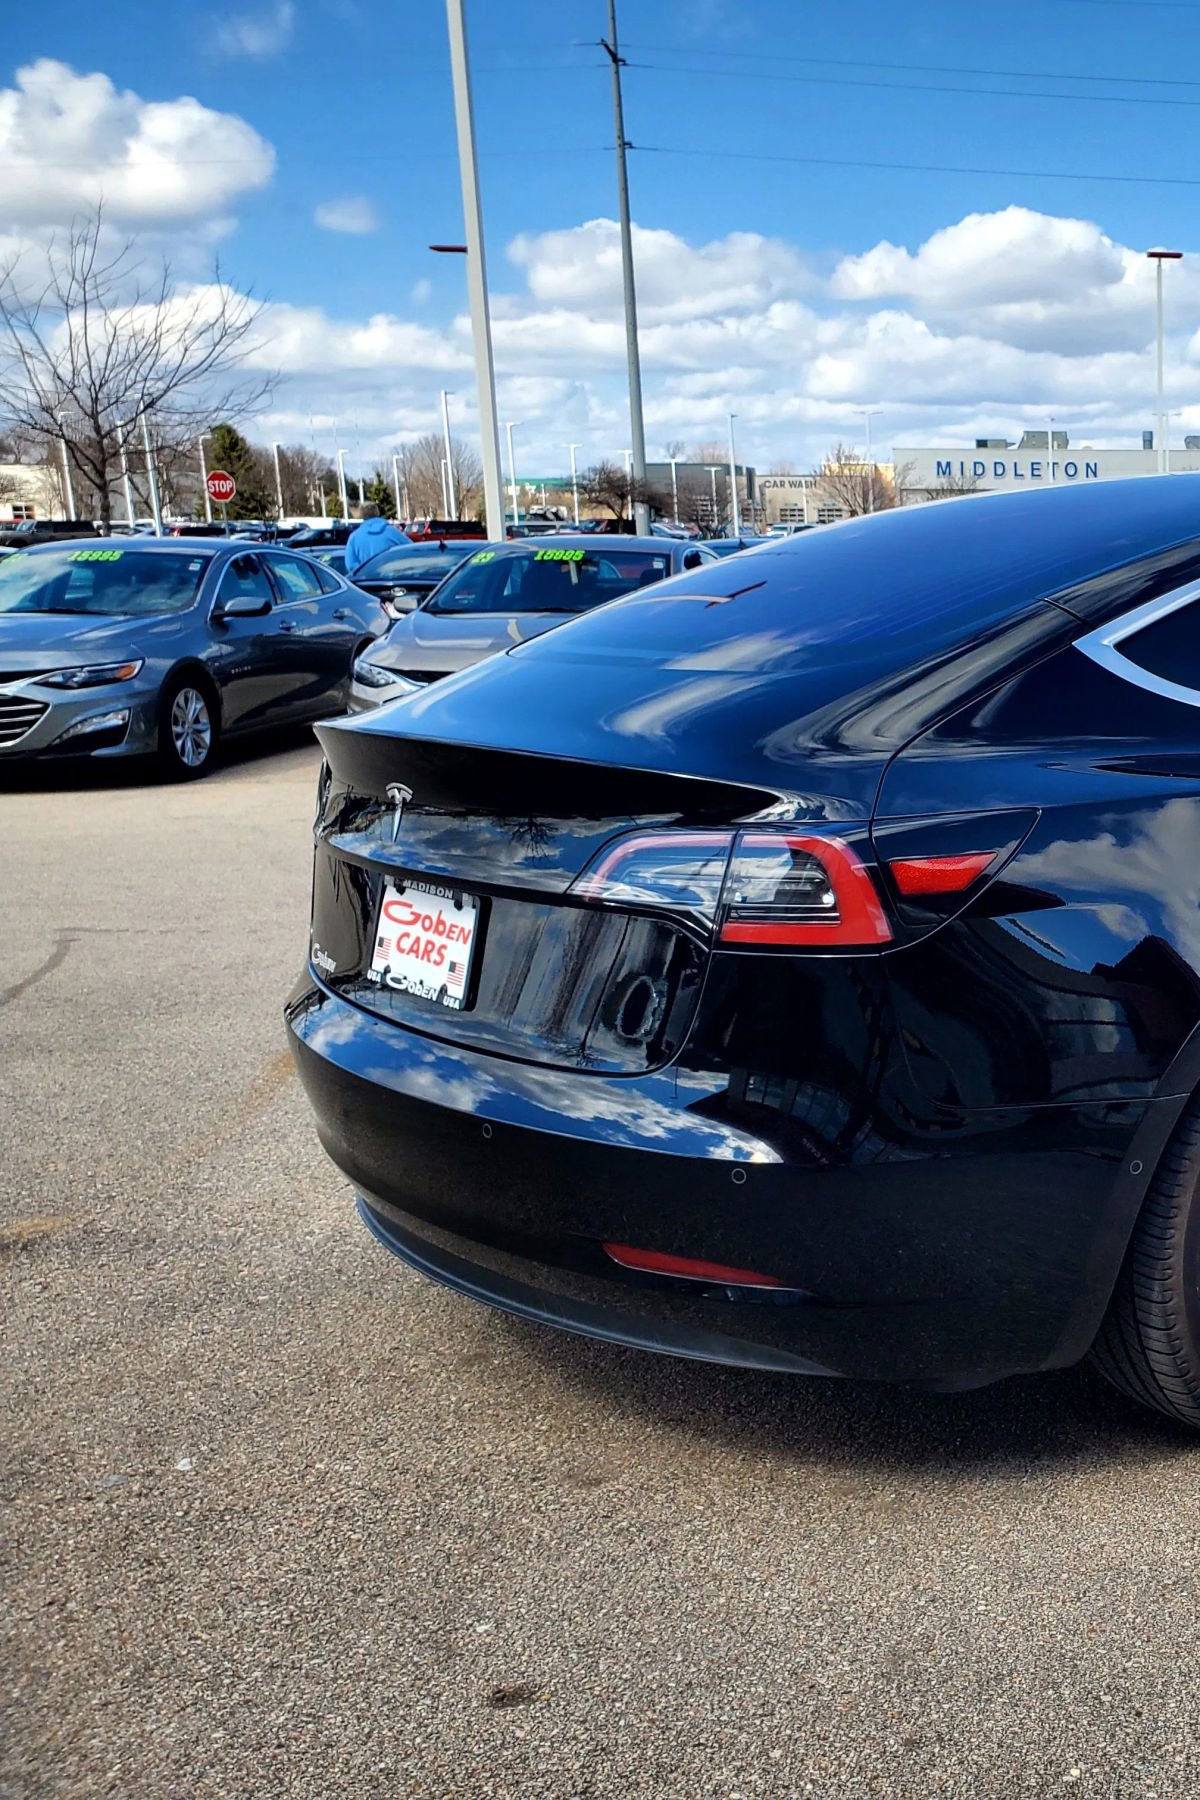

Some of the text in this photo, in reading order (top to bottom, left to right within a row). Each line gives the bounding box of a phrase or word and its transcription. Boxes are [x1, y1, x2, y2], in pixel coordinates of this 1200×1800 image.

[936, 461, 1098, 478] MIDDLETON
[207, 480, 234, 493] STOP
[763, 480, 817, 489] CAR WASH
[402, 880, 454, 899] MADISON
[396, 932, 448, 967] CARS
[366, 969, 382, 983] USA
[442, 995, 461, 1010] USA
